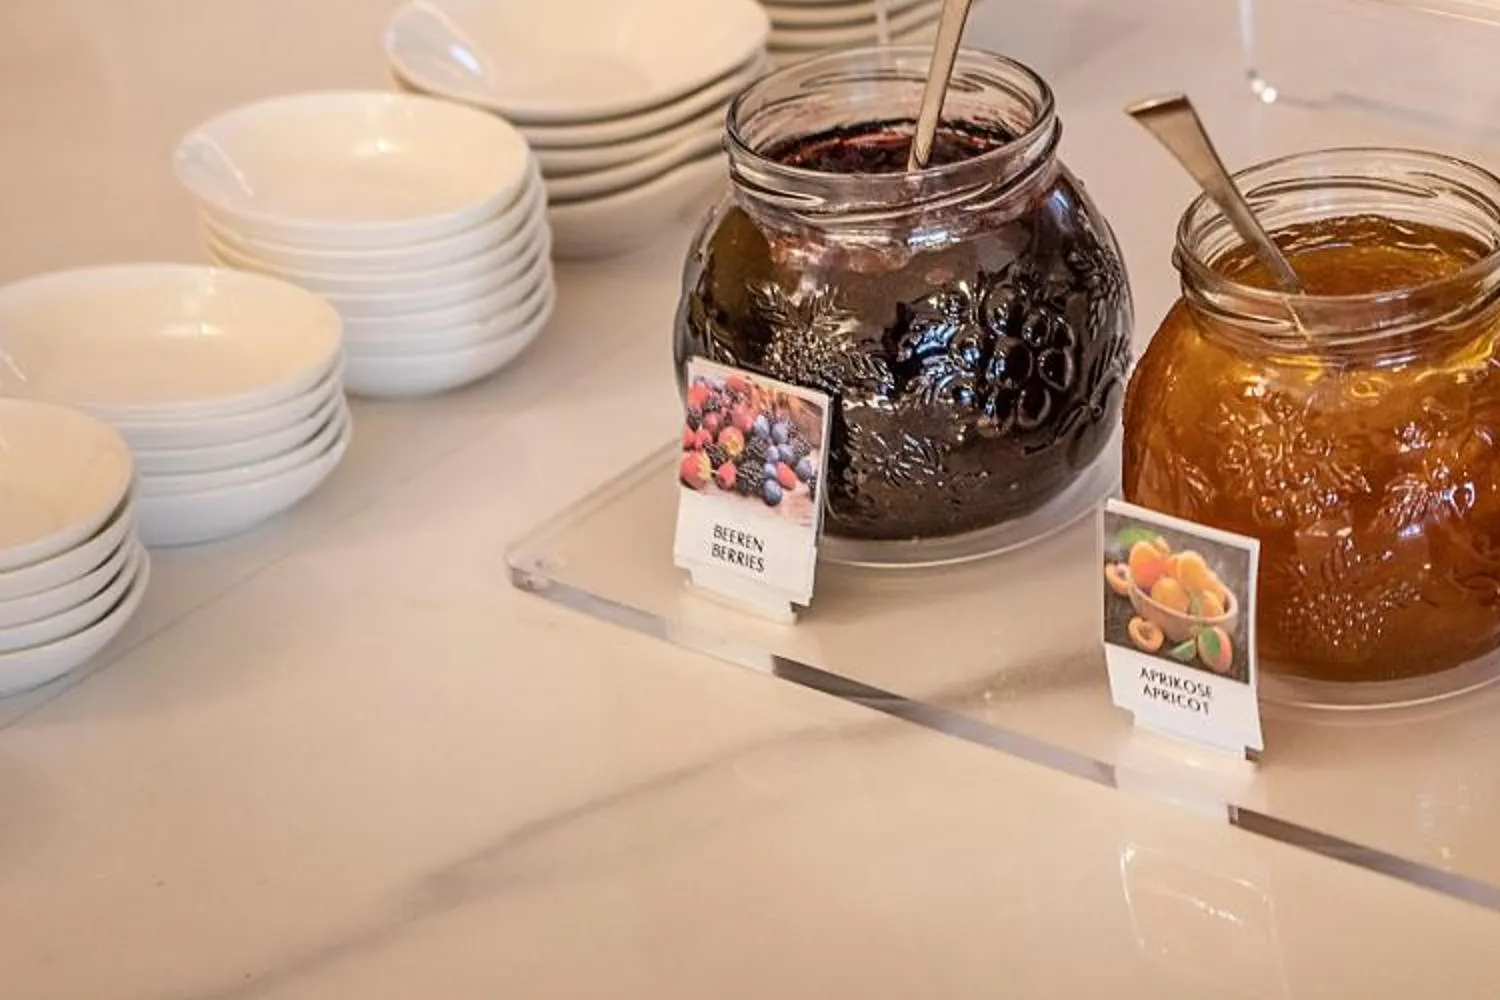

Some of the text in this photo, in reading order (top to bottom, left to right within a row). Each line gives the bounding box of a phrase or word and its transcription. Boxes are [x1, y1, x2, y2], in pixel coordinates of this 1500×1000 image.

[713, 524, 764, 553] BEEREN
[711, 543, 765, 573] BERRIES
[1139, 667, 1213, 699] APRIKOSE
[1143, 684, 1209, 716] APRICOT
